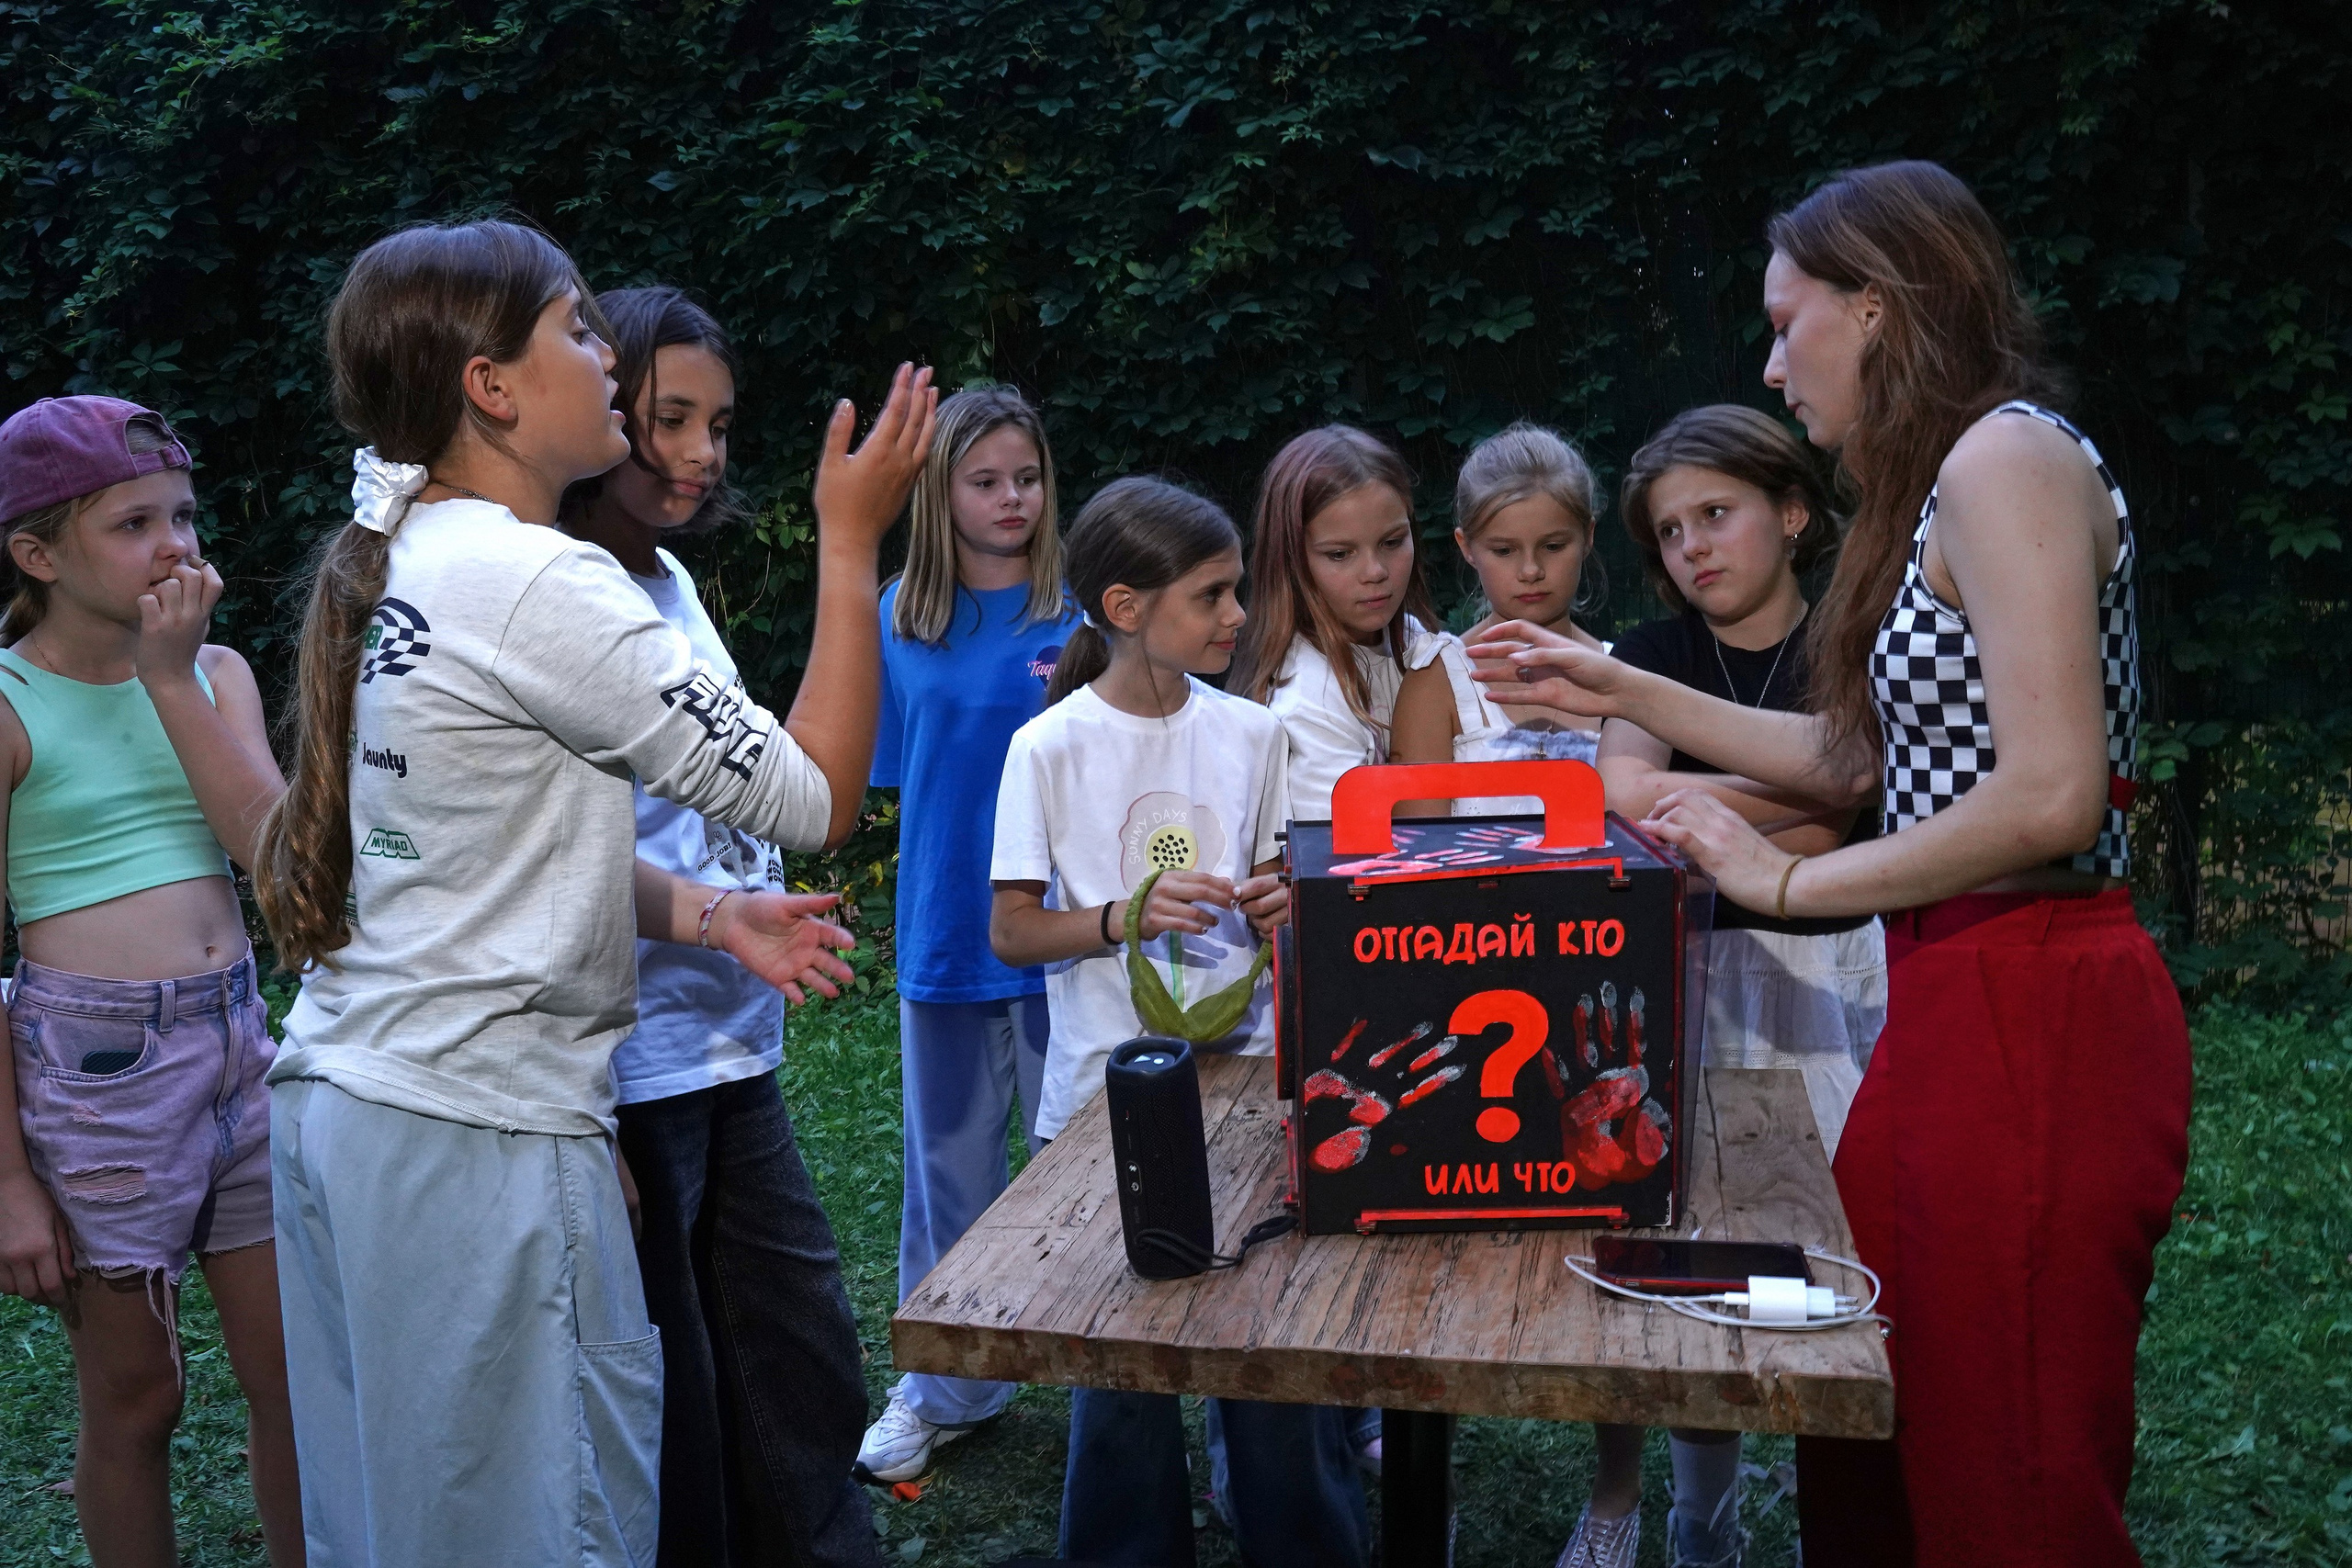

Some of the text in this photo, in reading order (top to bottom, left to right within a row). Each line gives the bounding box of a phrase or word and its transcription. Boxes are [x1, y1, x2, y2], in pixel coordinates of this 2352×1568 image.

[370, 836, 408, 852] MYRIAD
[1128, 808, 1187, 865] SUNNY DAYS
[697, 855, 715, 872] GOOD
[1353, 913, 1625, 964] ОТГАДАЙ КТО
[1424, 1161, 1576, 1195] ИЛИ ЧТО
